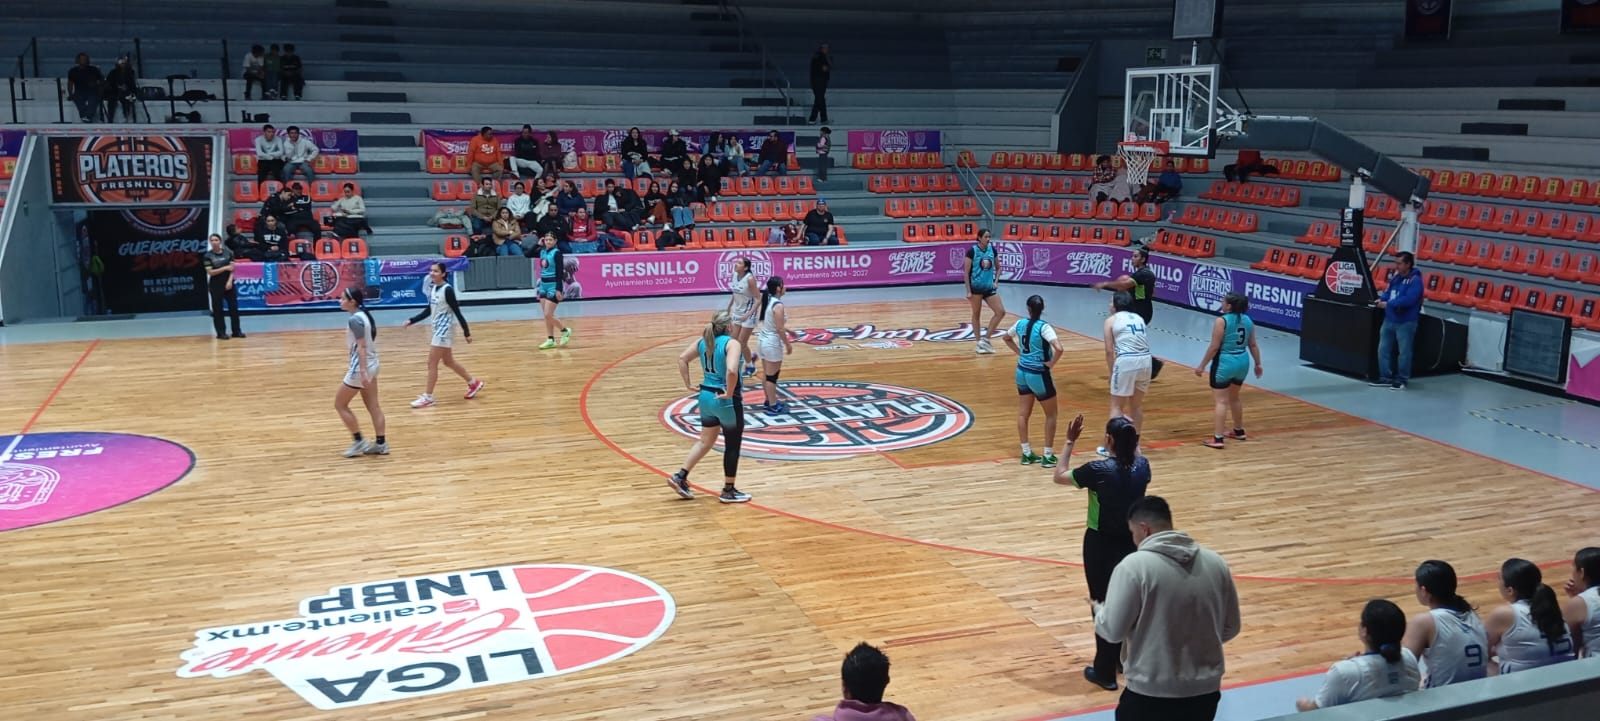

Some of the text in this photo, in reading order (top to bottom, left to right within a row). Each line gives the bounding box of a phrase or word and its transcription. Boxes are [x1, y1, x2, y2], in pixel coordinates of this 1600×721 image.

[79, 153, 189, 181] PLATEROS
[101, 181, 173, 190] FRESNILLO
[118, 238, 208, 256] GUERREROS
[783, 254, 872, 270] FRESNILLO
[888, 251, 937, 262] GUERREROS
[1066, 252, 1113, 264] GUERREROS
[601, 260, 699, 278] FRESNILLO
[889, 260, 935, 273] SOMOS
[1068, 260, 1112, 275] SOMOS
[1122, 259, 1183, 282] FRNILLO
[605, 278, 654, 288] Ayuntamiento
[655, 277, 673, 285] 2024
[679, 276, 696, 284] 2027
[786, 272, 830, 281] Ayuntamiento
[831, 271, 848, 279] 2024
[1191, 274, 1232, 296] PLATEROS
[1248, 302, 1301, 318] yuntamiento 2024
[1126, 323, 1145, 335] 14
[1236, 327, 1246, 345] 3
[703, 351, 716, 374] 11
[13, 443, 101, 453] Ayuntamient
[308, 570, 508, 615] LNBP
[207, 603, 439, 643] caliente.mx
[189, 608, 526, 673] Caliente
[1464, 643, 1482, 667] 9
[305, 647, 545, 704] LIGA
